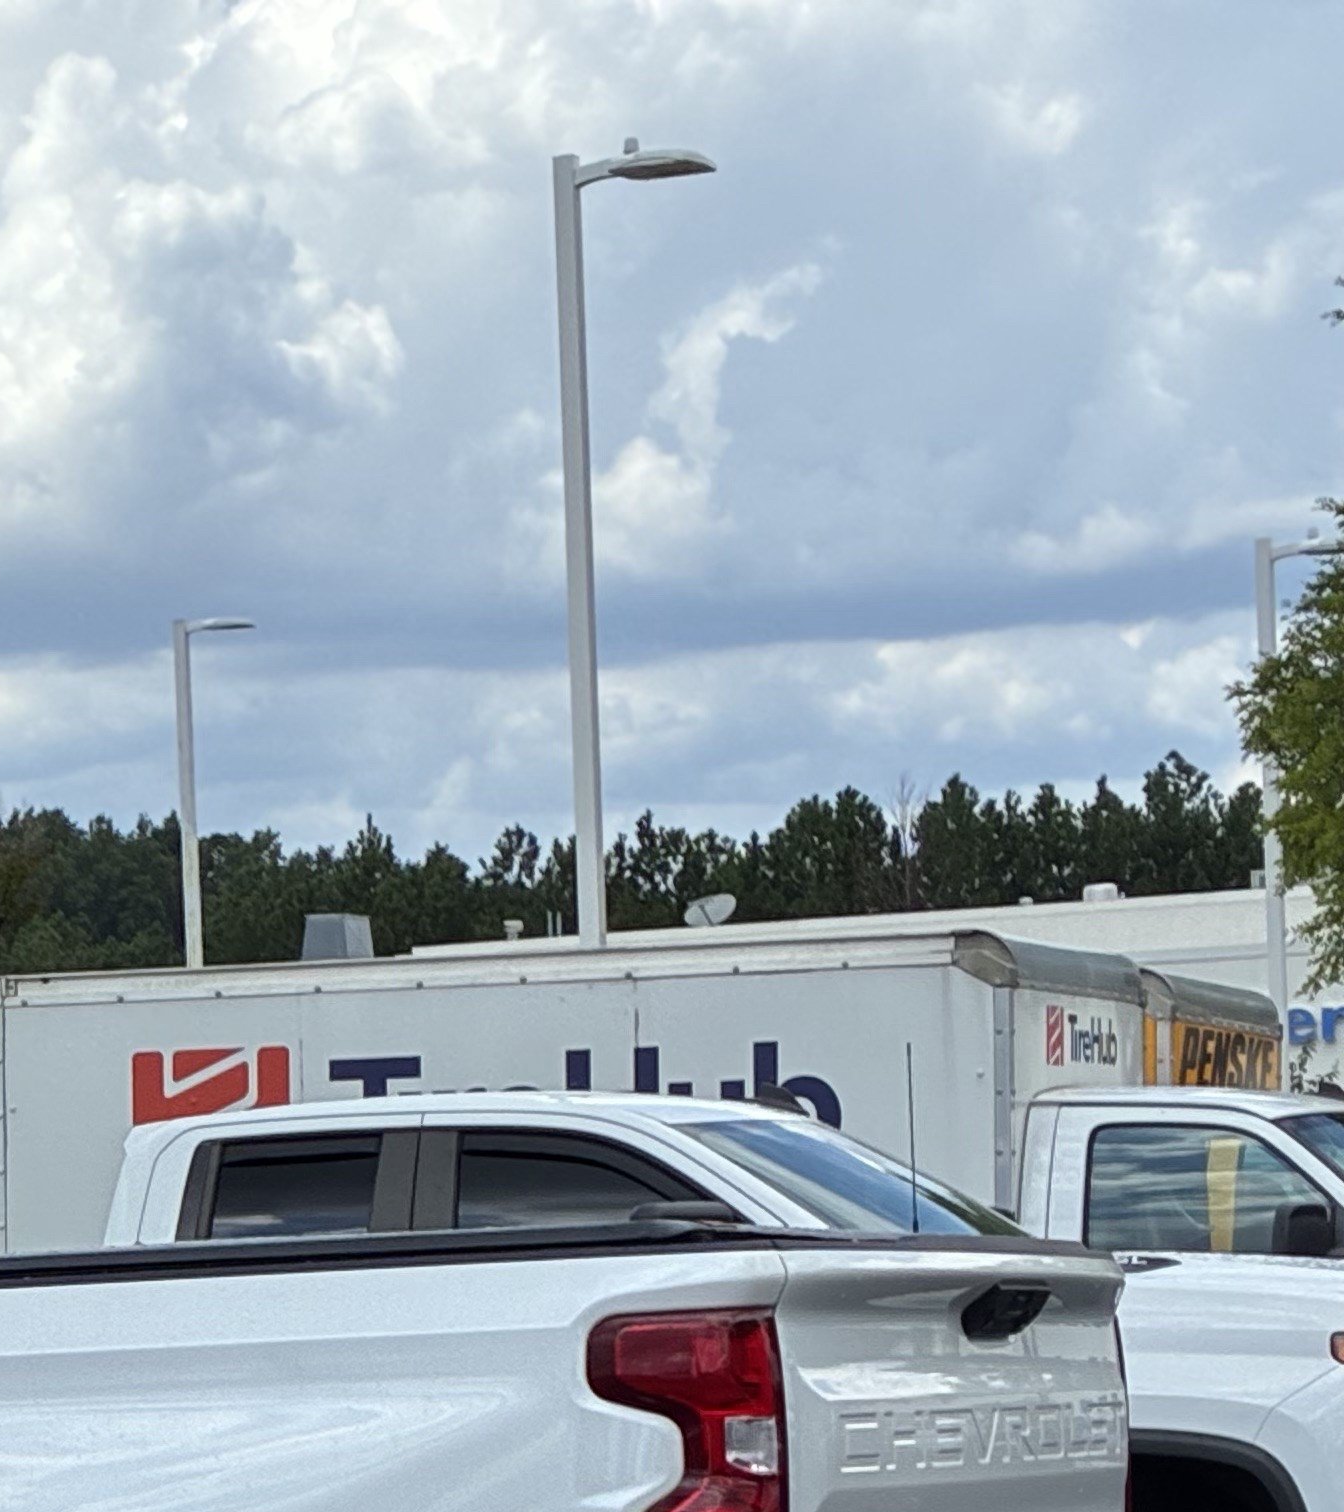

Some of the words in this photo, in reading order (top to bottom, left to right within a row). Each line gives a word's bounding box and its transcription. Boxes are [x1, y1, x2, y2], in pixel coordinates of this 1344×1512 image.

[1068, 1013, 1117, 1067] TireHub
[1179, 1026, 1275, 1090] PENSKE
[839, 1402, 1124, 1474] CHEVROLET
